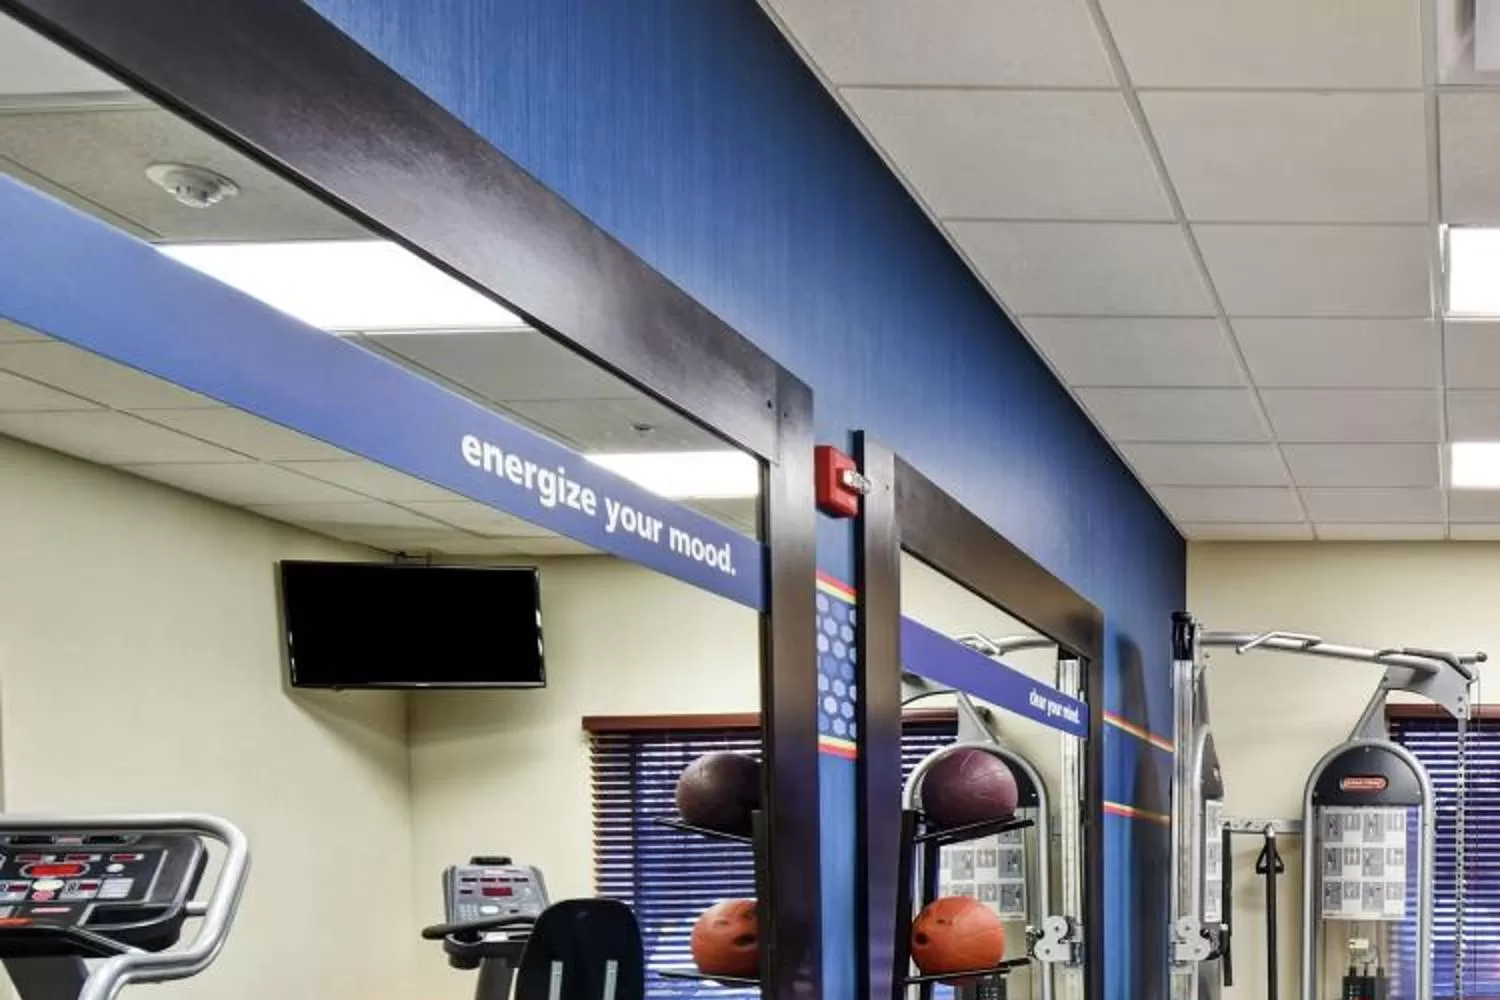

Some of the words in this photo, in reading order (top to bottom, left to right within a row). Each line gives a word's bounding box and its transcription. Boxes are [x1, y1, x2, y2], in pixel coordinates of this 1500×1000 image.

[461, 434, 597, 516] energize
[604, 497, 663, 543] your
[669, 527, 737, 576] mood.
[1047, 699, 1063, 718] your
